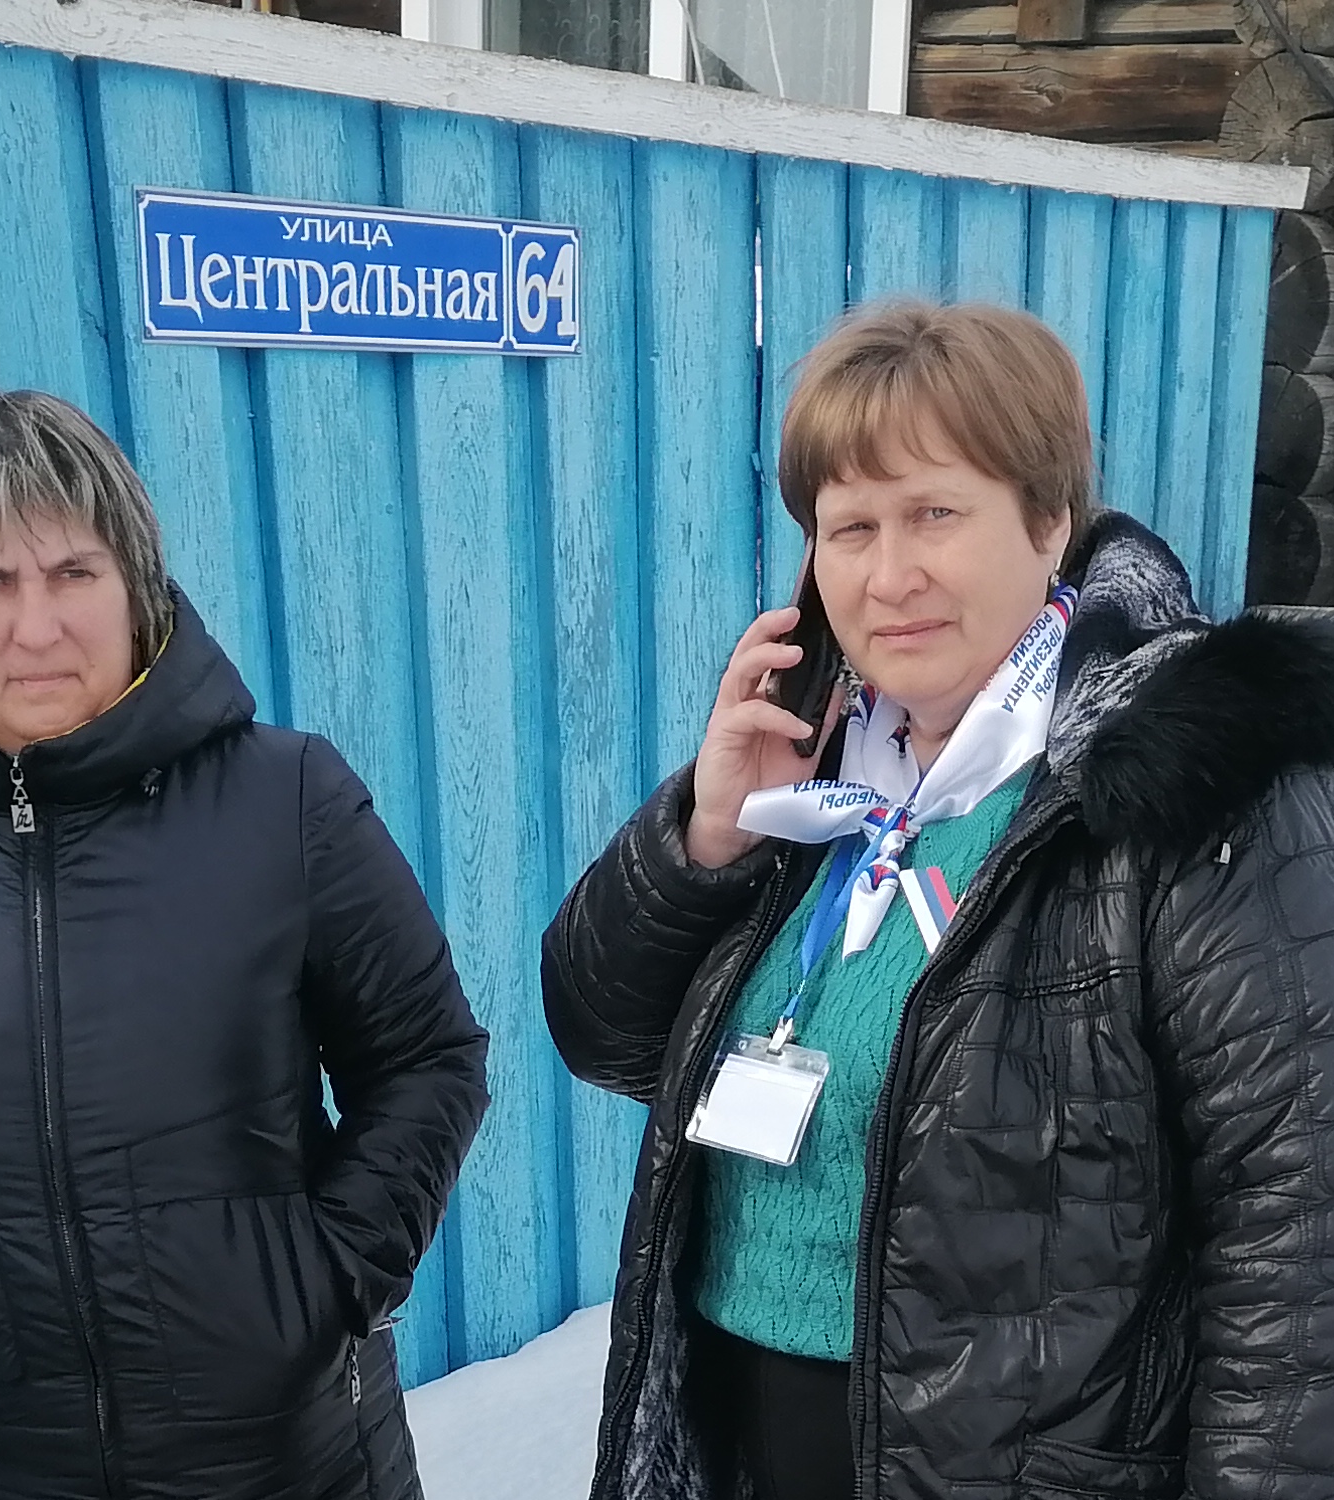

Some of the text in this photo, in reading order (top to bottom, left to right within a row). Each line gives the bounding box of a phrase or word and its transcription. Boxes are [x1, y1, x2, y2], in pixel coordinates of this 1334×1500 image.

[279, 215, 394, 251] УЛИЦА
[154, 231, 498, 333] Центральная
[516, 241, 576, 336] 64
[1001, 623, 1063, 714] ПРЕЗИДЕНТА
[1009, 610, 1053, 669] РОССИИ
